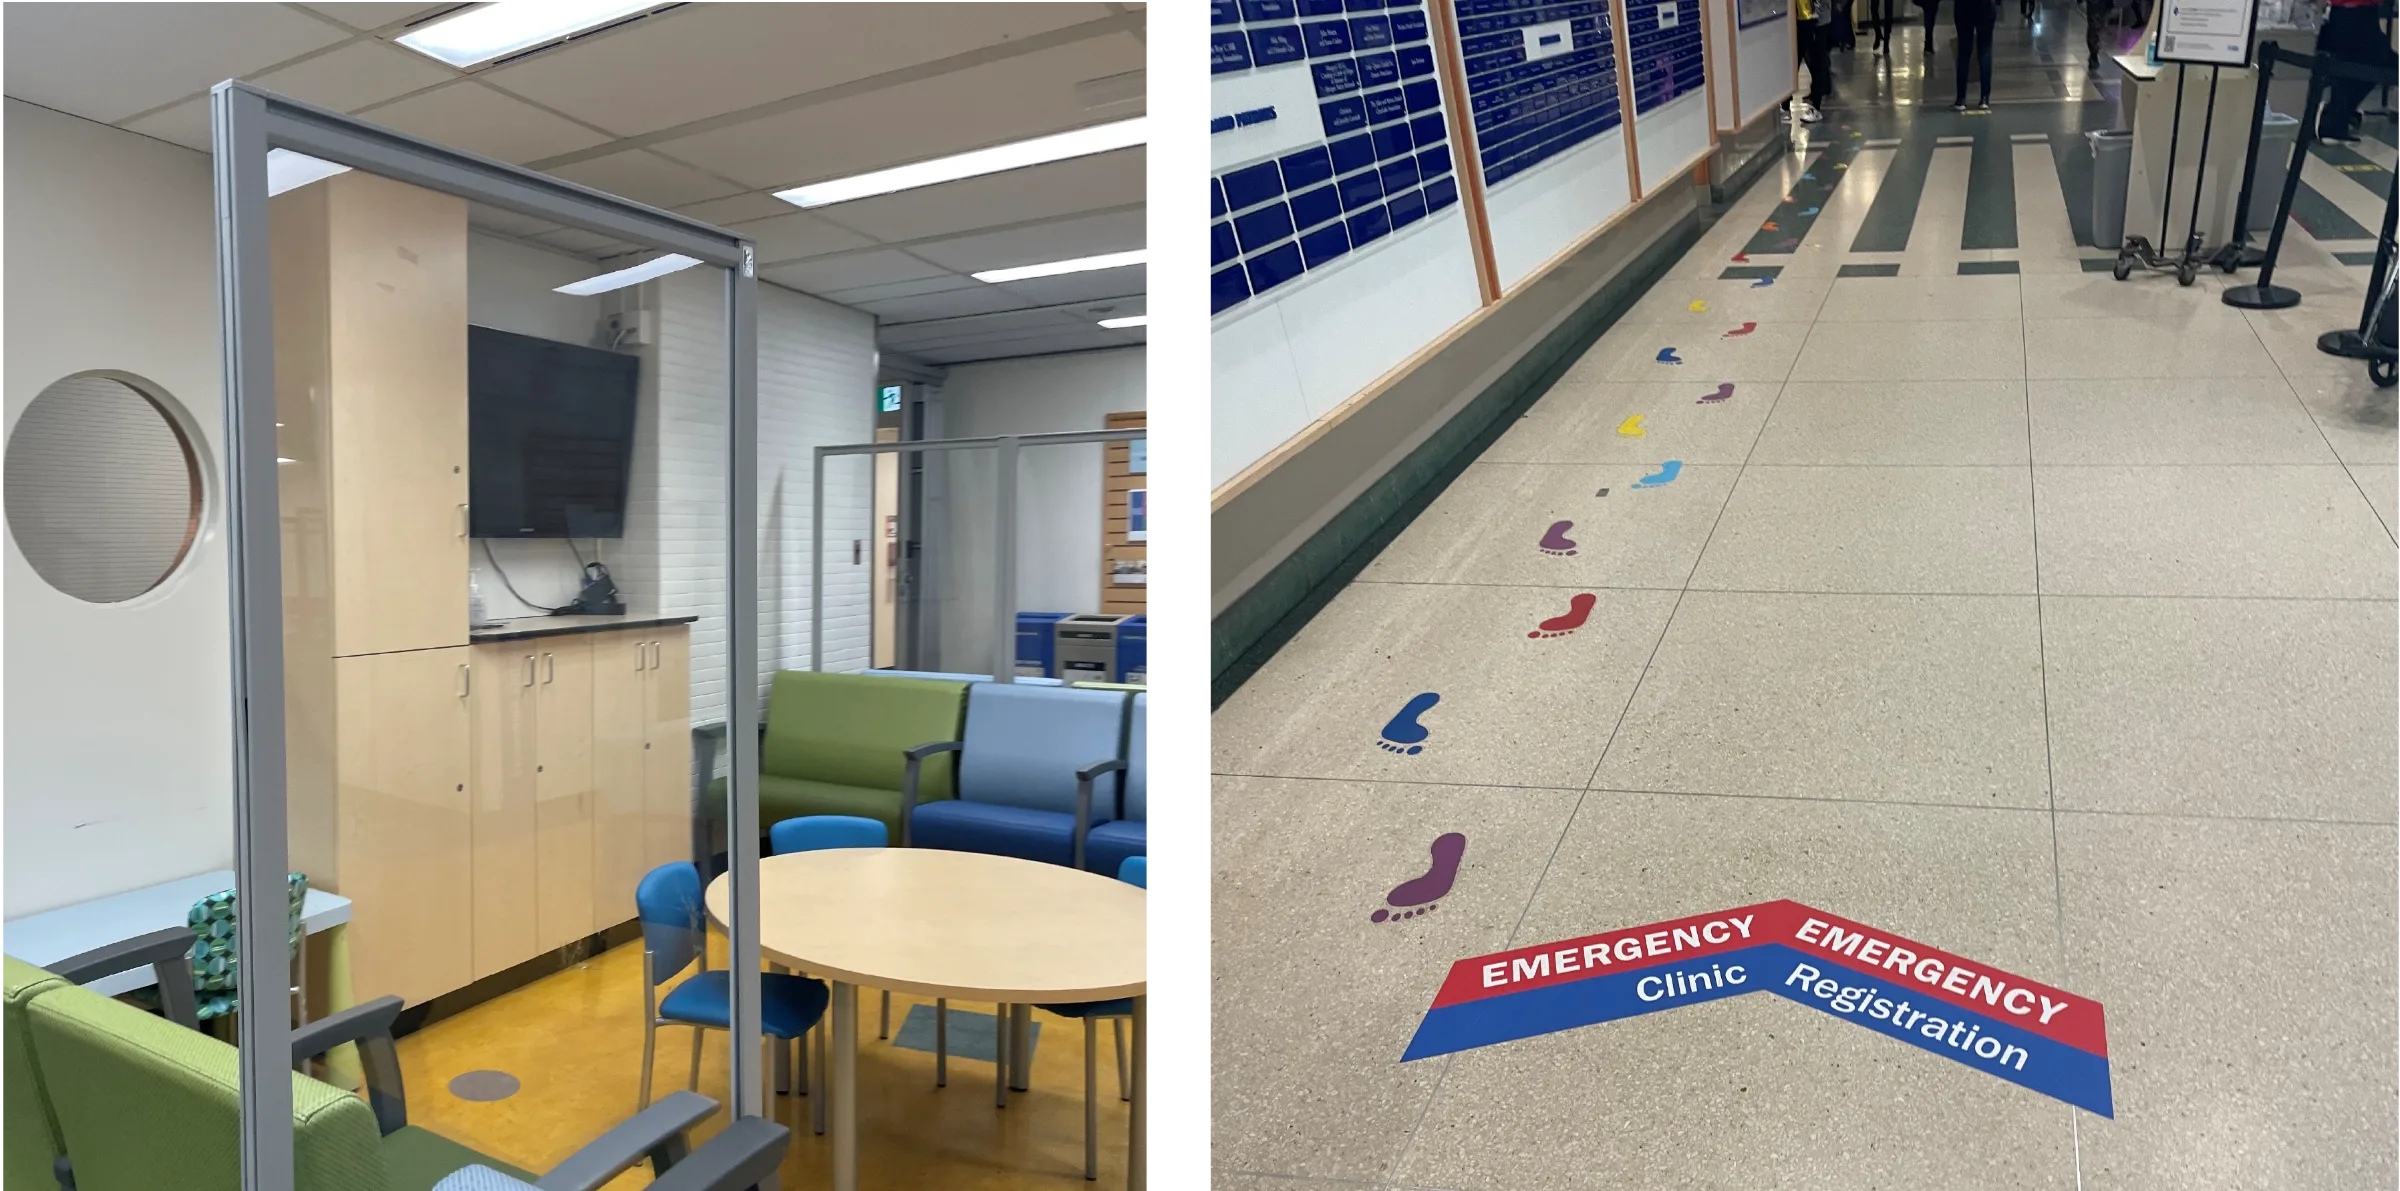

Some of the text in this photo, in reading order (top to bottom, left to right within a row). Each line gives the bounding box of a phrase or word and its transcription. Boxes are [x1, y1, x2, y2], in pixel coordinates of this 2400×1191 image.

[1481, 914, 1755, 989] EMERGENCY
[1635, 961, 1748, 1003] Clinic
[1794, 916, 2070, 1025] EMERGENCY
[1784, 961, 2029, 1072] Registration
